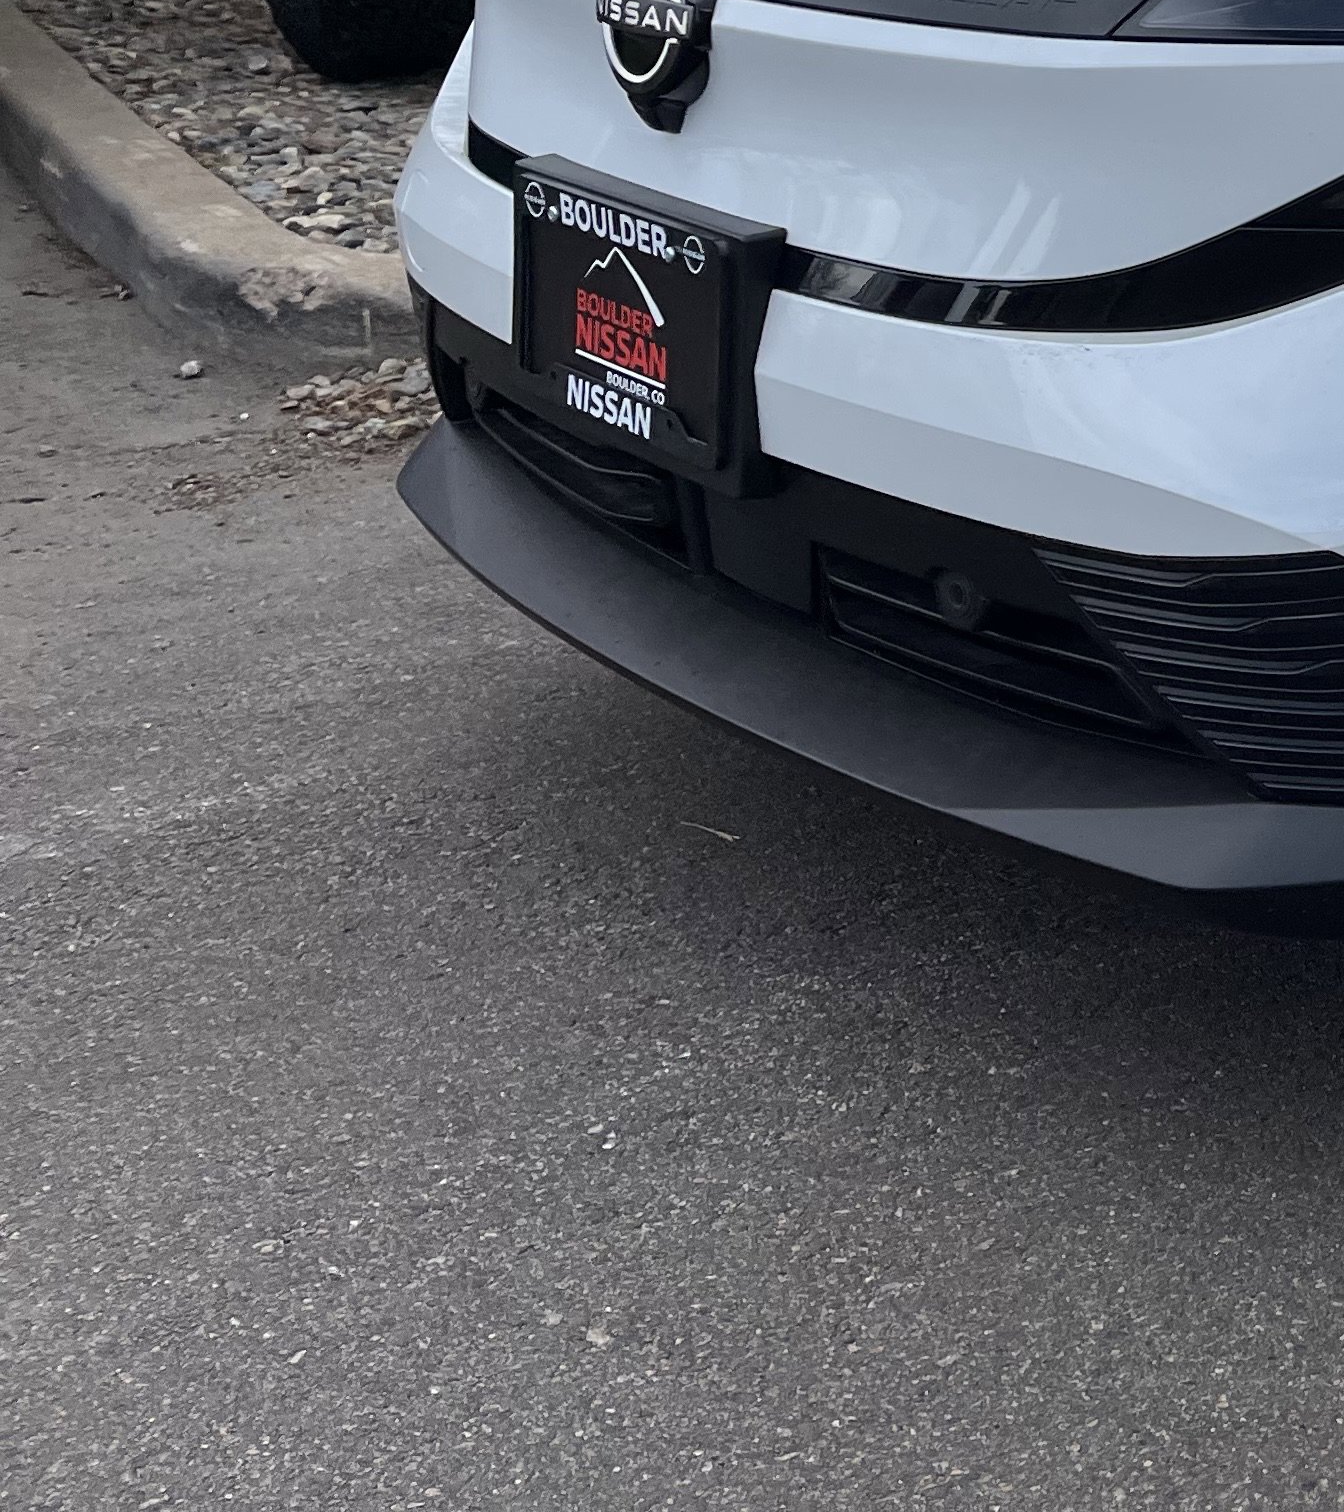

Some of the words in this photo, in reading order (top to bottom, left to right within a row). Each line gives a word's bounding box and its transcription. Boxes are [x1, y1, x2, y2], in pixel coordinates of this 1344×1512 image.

[559, 192, 667, 260] BOULDER
[576, 287, 655, 336] BOULDER
[576, 313, 667, 382] NISSAN
[566, 374, 652, 440] NISSAN
[651, 389, 666, 406] CO
